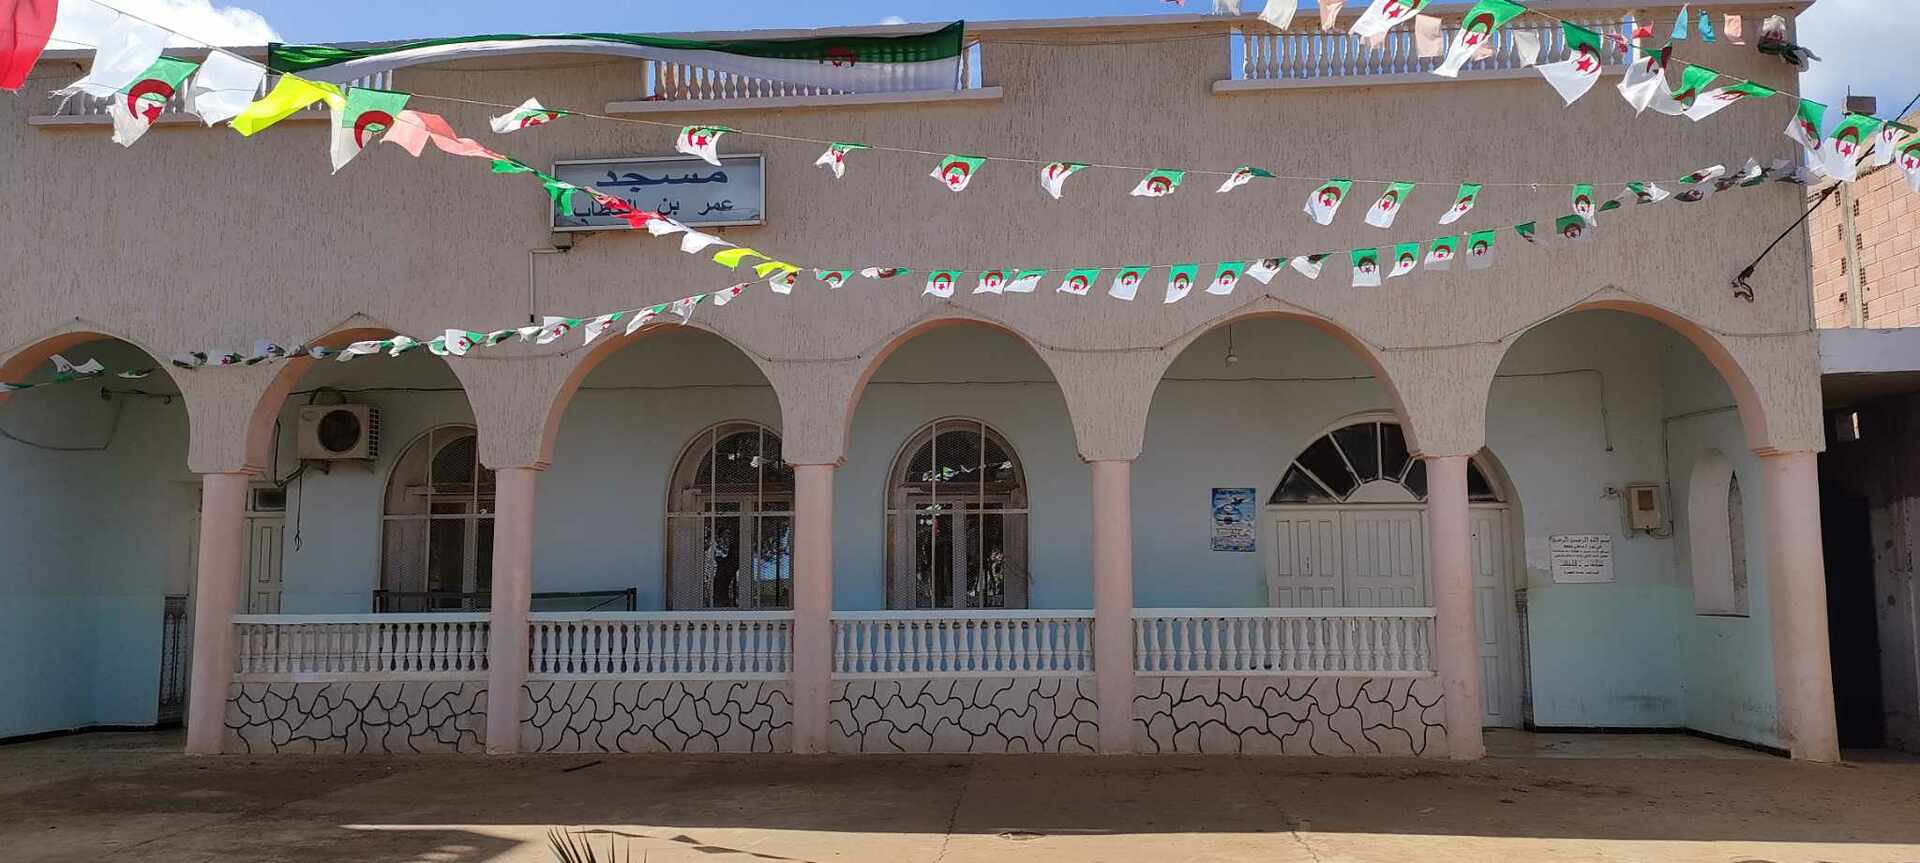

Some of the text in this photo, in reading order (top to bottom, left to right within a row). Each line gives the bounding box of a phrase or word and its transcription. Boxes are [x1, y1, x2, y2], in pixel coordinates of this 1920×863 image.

[596, 170, 728, 192] مسجد
[573, 198, 734, 226] عمر بن اطاب
